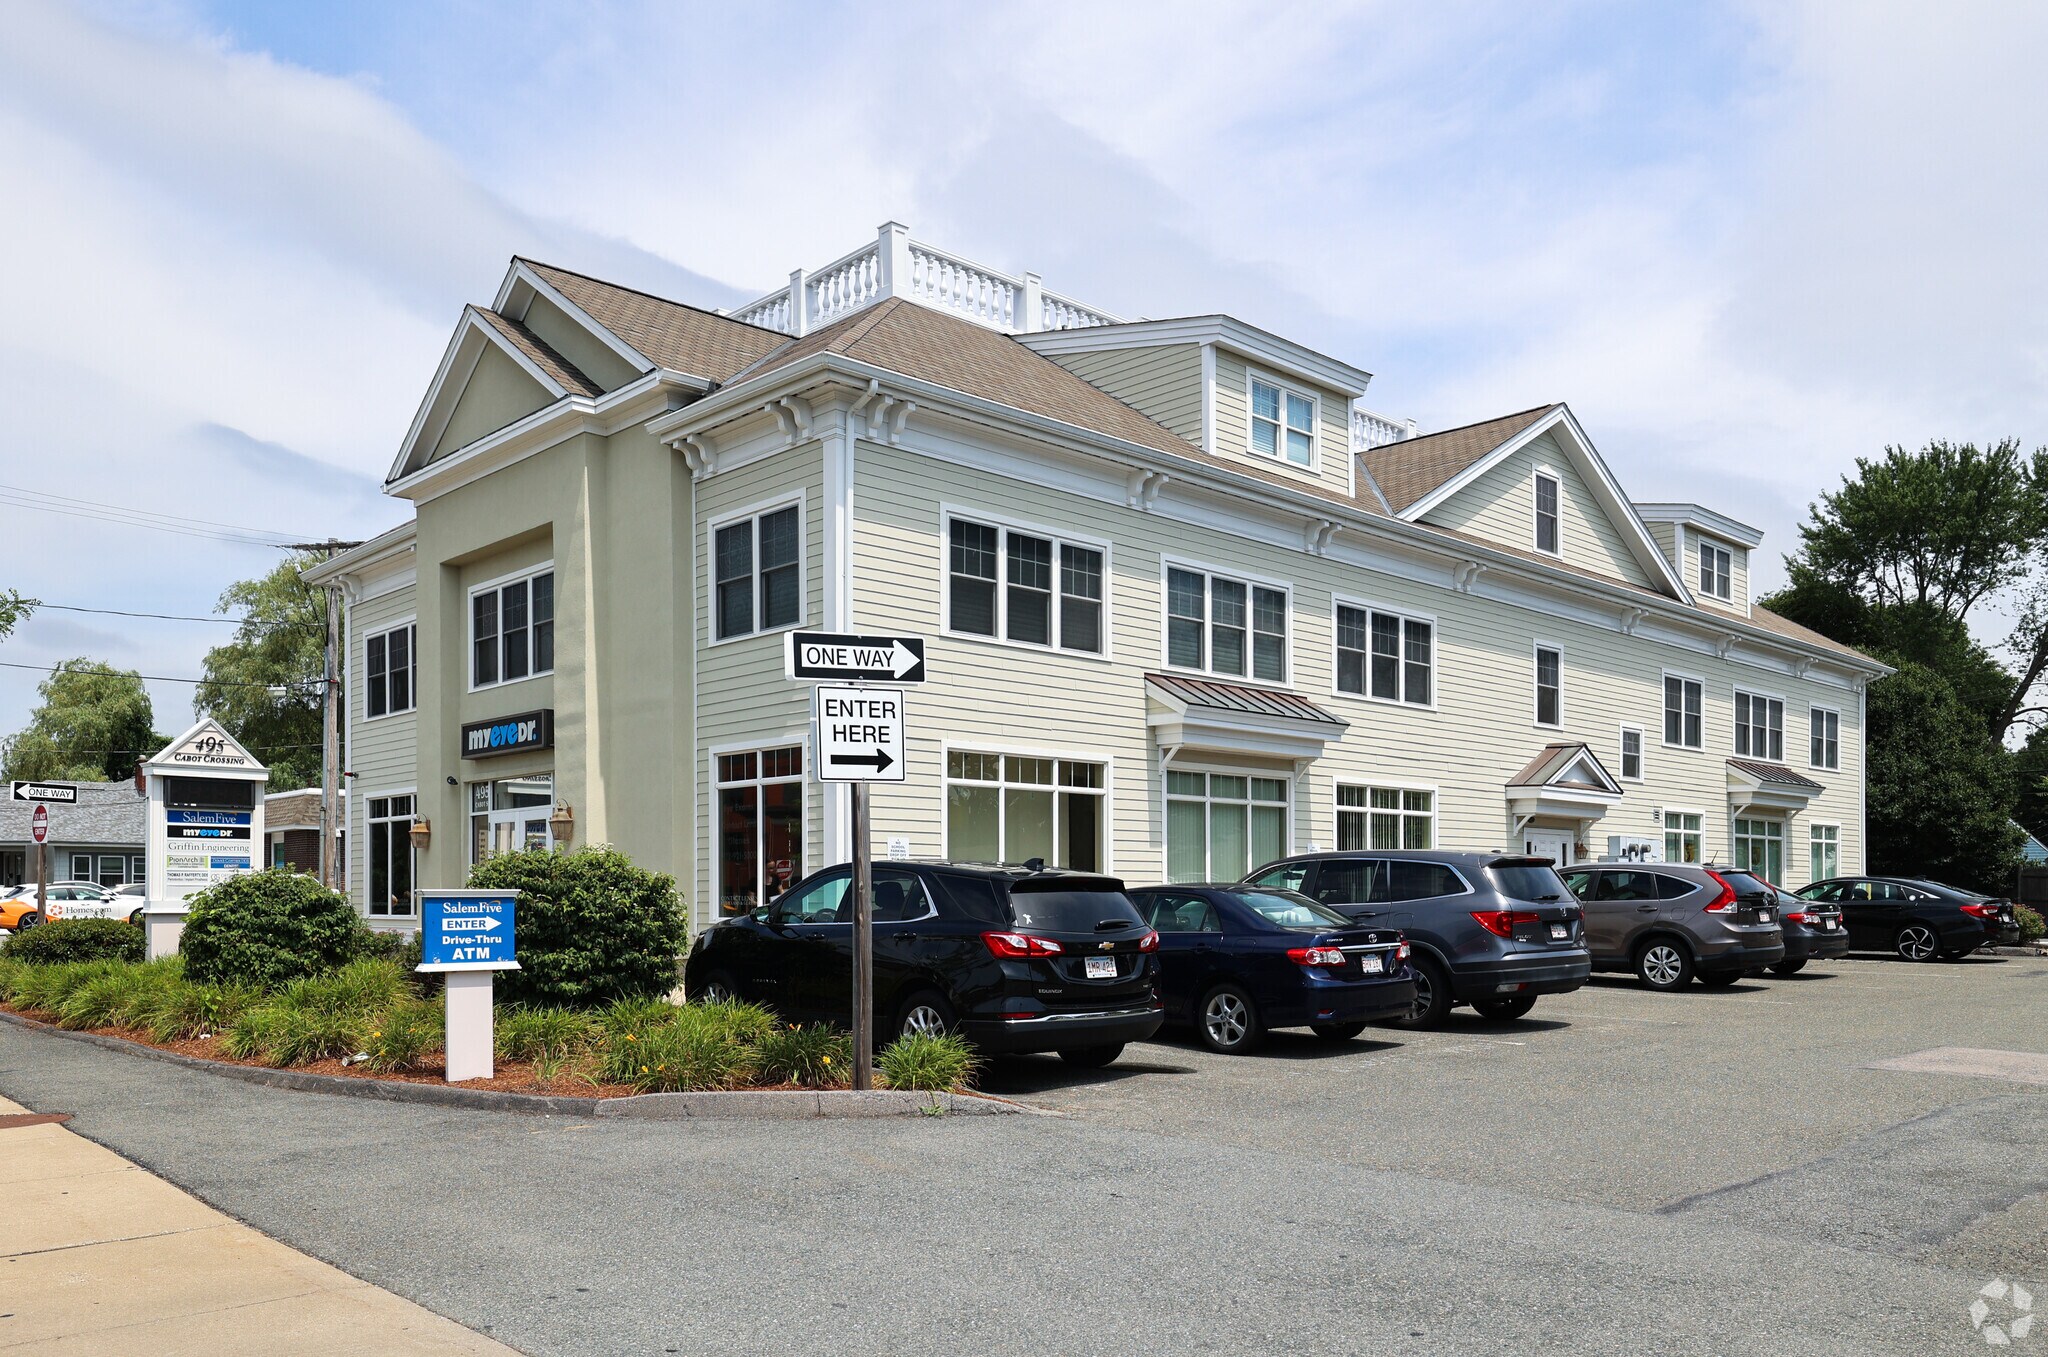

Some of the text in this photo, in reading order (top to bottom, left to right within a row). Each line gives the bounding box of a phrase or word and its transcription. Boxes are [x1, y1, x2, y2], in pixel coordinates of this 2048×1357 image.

[806, 646, 895, 668] ONE WAY
[825, 699, 896, 719] ENTER
[833, 724, 891, 743] HERE
[195, 736, 225, 754] 495
[174, 753, 245, 765] CABOT CROSSING
[28, 788, 72, 798] ONE WAY
[168, 842, 250, 853] Griffin Engineering
[446, 919, 487, 929] ENTER
[442, 935, 502, 945] Drive-Thru
[452, 947, 490, 960] ATM
